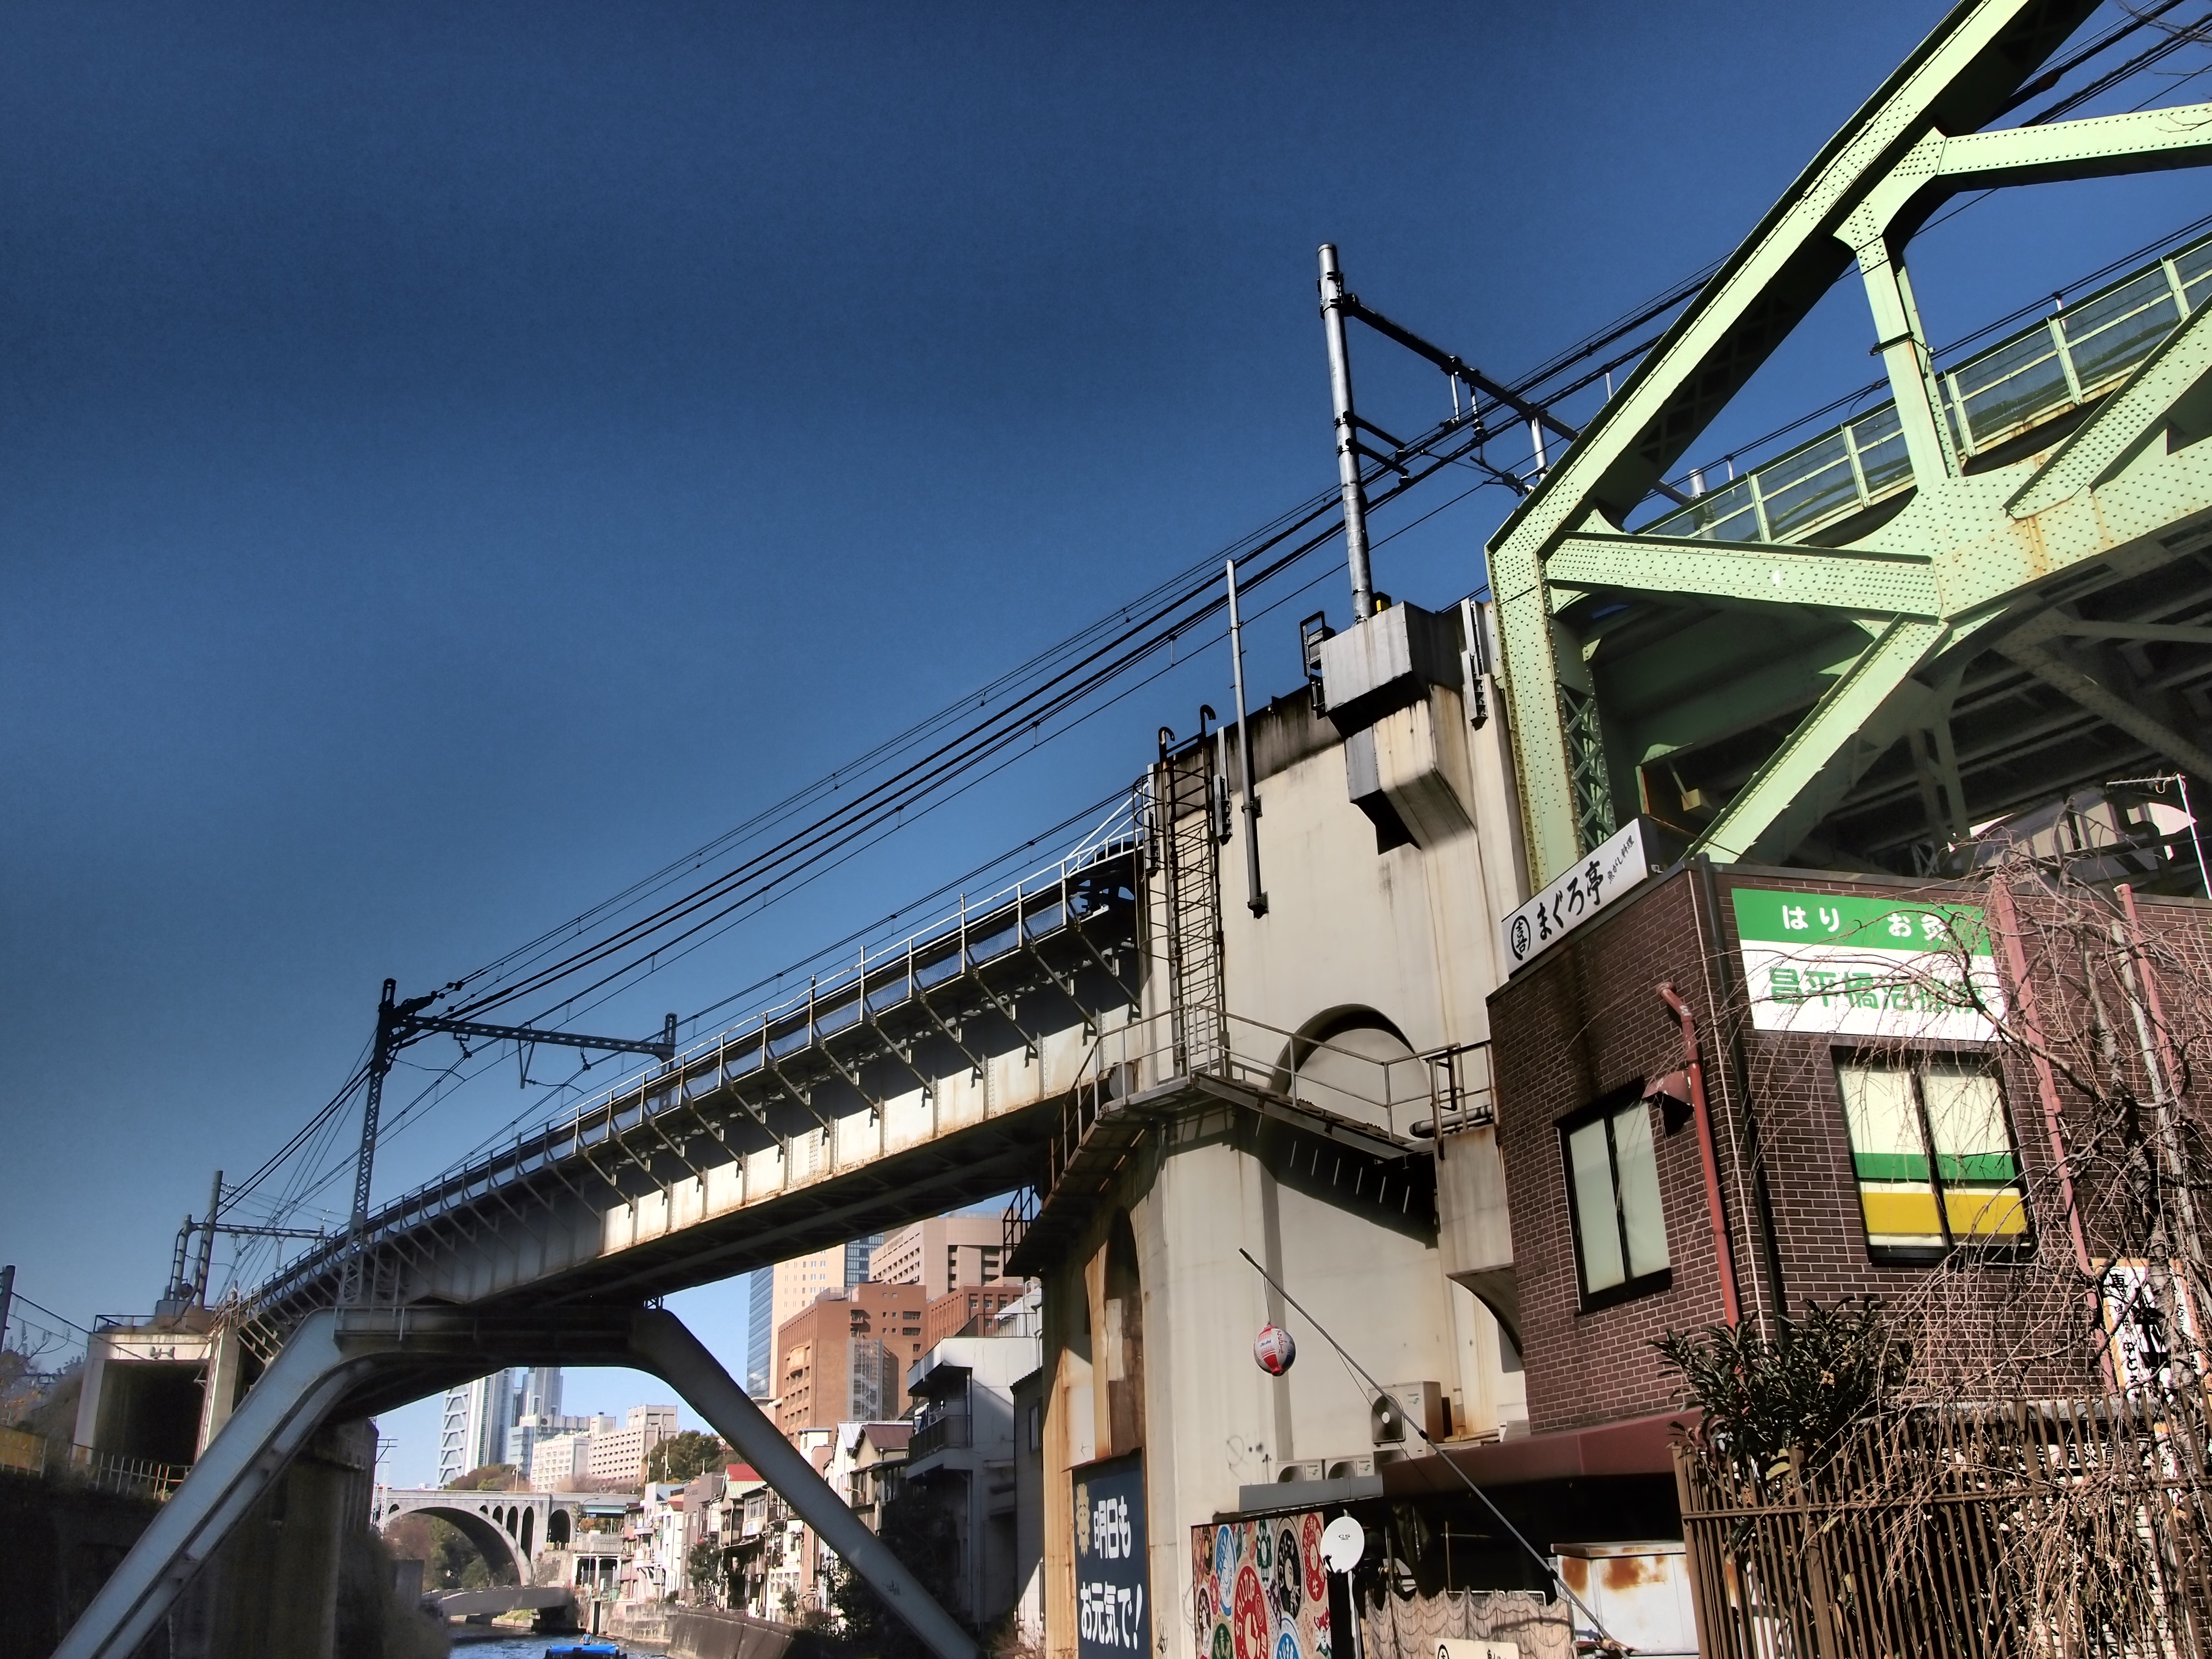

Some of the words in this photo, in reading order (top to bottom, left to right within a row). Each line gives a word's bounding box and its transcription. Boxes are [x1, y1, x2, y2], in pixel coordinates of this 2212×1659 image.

[1537, 860, 1604, 940] まぐろ亭
[1782, 905, 1839, 932] はり
[1093, 1495, 1131, 1559] 明日も
[1080, 1581, 1143, 1650] お元気で！
